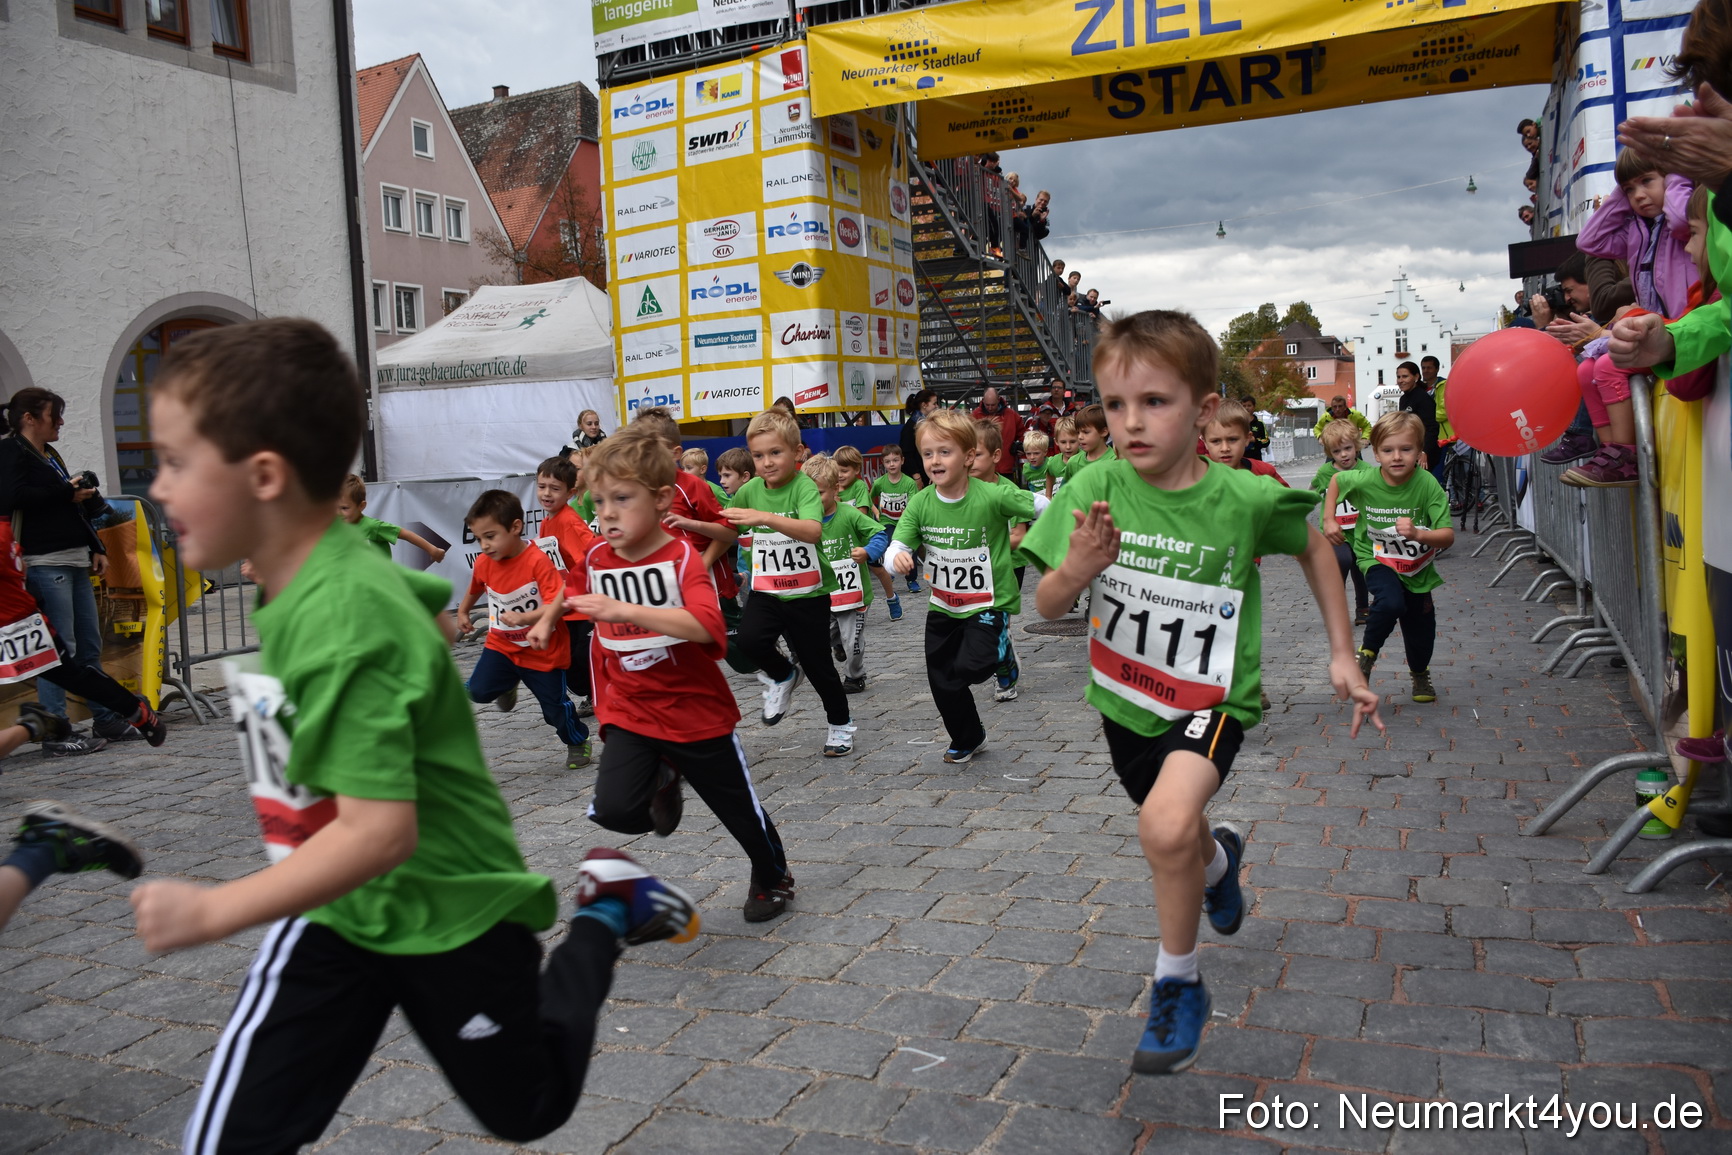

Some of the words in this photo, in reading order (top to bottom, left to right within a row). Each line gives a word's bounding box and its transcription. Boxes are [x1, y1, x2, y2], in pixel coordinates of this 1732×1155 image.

[1071, 0, 1242, 56] ZIEL
[841, 61, 920, 81] Neumarkter
[922, 48, 982, 71] Stadtlauf
[1368, 58, 1450, 76] Neumarkter
[1453, 44, 1521, 63] Stadtlauf
[1107, 46, 1326, 119] START
[721, 90, 741, 99] KANN
[948, 114, 1014, 133] Neumarkter
[1016, 106, 1070, 124] Stadtlauf
[779, 123, 813, 135] Neumarkter
[688, 130, 729, 151] swn
[715, 141, 740, 152] neumarkt
[634, 245, 676, 261] VARIOTEC
[716, 247, 731, 256] KIA
[792, 270, 812, 280] MINI
[697, 335, 729, 345] Neumarkter
[730, 332, 754, 342] Tagblatt
[711, 386, 761, 399] VARIOTEC
[804, 388, 822, 400] DEHN
[1365, 505, 1411, 515] Neumarkter
[757, 546, 812, 573] 7143
[941, 555, 976, 563] Neumarkt
[928, 561, 985, 590] 7126
[773, 578, 799, 588] Kilian
[945, 594, 964, 605] Tim
[1140, 587, 1215, 615] Neumarkt
[1102, 593, 1217, 675] 7111
[1120, 662, 1177, 702] Simon
